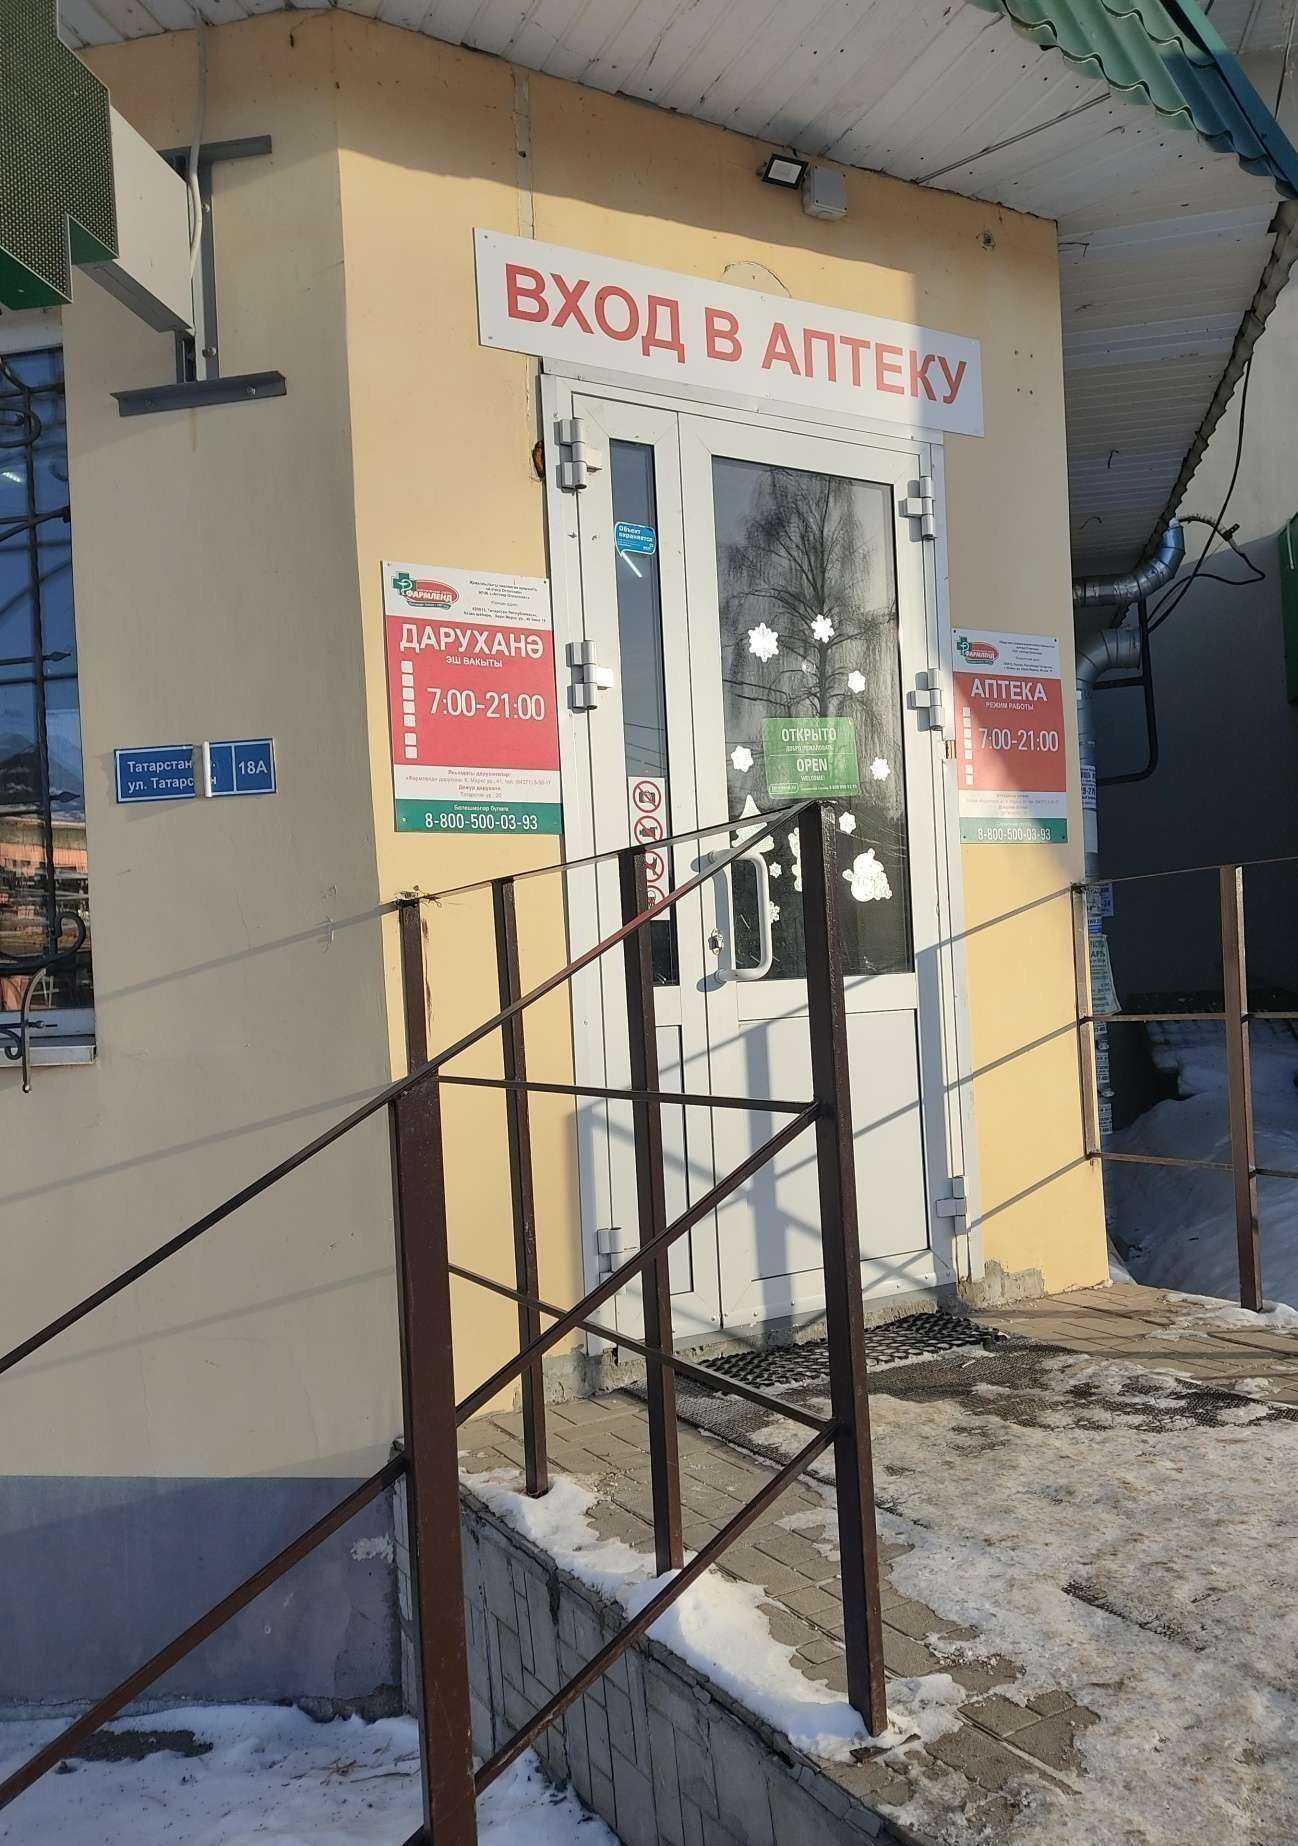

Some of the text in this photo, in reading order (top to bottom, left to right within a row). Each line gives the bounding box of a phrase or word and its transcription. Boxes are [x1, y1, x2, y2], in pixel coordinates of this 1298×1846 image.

[505, 262, 967, 404] ВХОД В АПТЕКУ
[406, 589, 453, 602] ФАРМЛЕНД
[400, 623, 544, 659] ДАРУХАНӘ
[446, 655, 503, 668] ЭШ ВАКЫТЫ
[970, 678, 1048, 702] АПТЕКА
[426, 687, 545, 721] 7:00-21:00
[985, 701, 1034, 711] РЕЖИМ РАБОТЫ
[781, 727, 837, 742] ОТКРЫТО
[978, 727, 1059, 752] 7:00-21:00
[127, 760, 193, 774] Татарстан
[238, 760, 268, 775] 18А
[796, 758, 828, 772] OPEN
[128, 777, 217, 793] ул. Татарсн
[425, 812, 538, 830] 8-800-500-03-93
[977, 828, 1051, 840] 8-800-500-03-93
